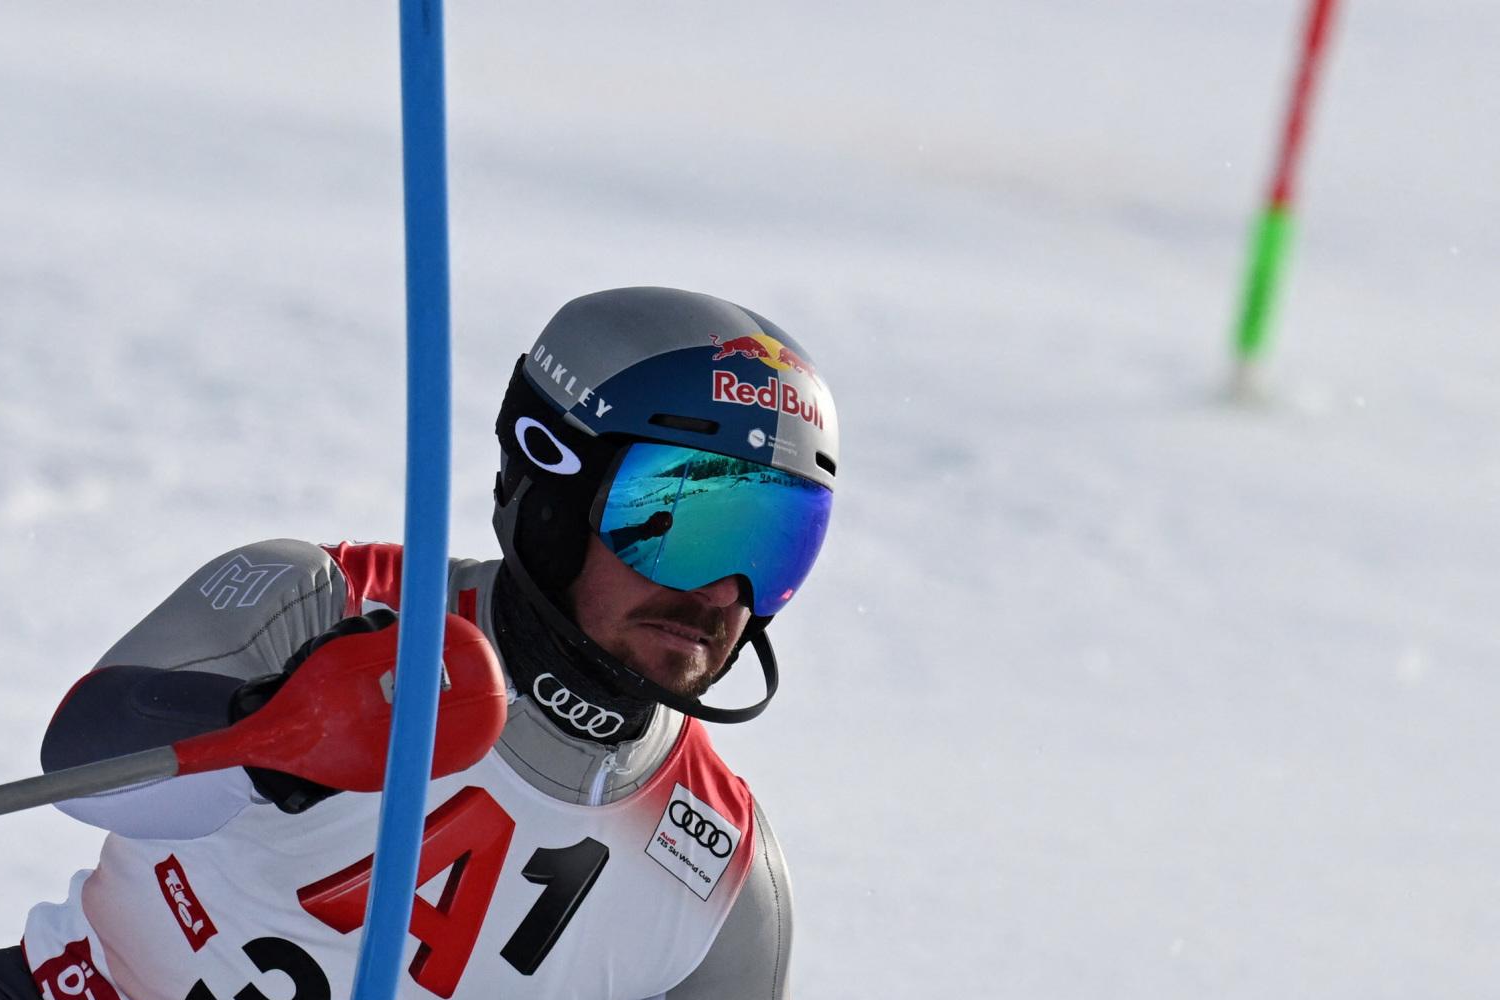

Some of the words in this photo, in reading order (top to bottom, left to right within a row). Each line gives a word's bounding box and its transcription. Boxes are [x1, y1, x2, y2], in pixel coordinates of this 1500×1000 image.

[533, 344, 613, 418] OAKLEY
[713, 369, 779, 411] Red
[781, 383, 824, 431] Bull
[657, 836, 668, 848] FIS
[668, 845, 679, 858] Ski
[679, 853, 699, 873] World
[698, 870, 712, 884] Cup
[660, 831, 677, 847] Audi
[296, 785, 610, 1000] A1
